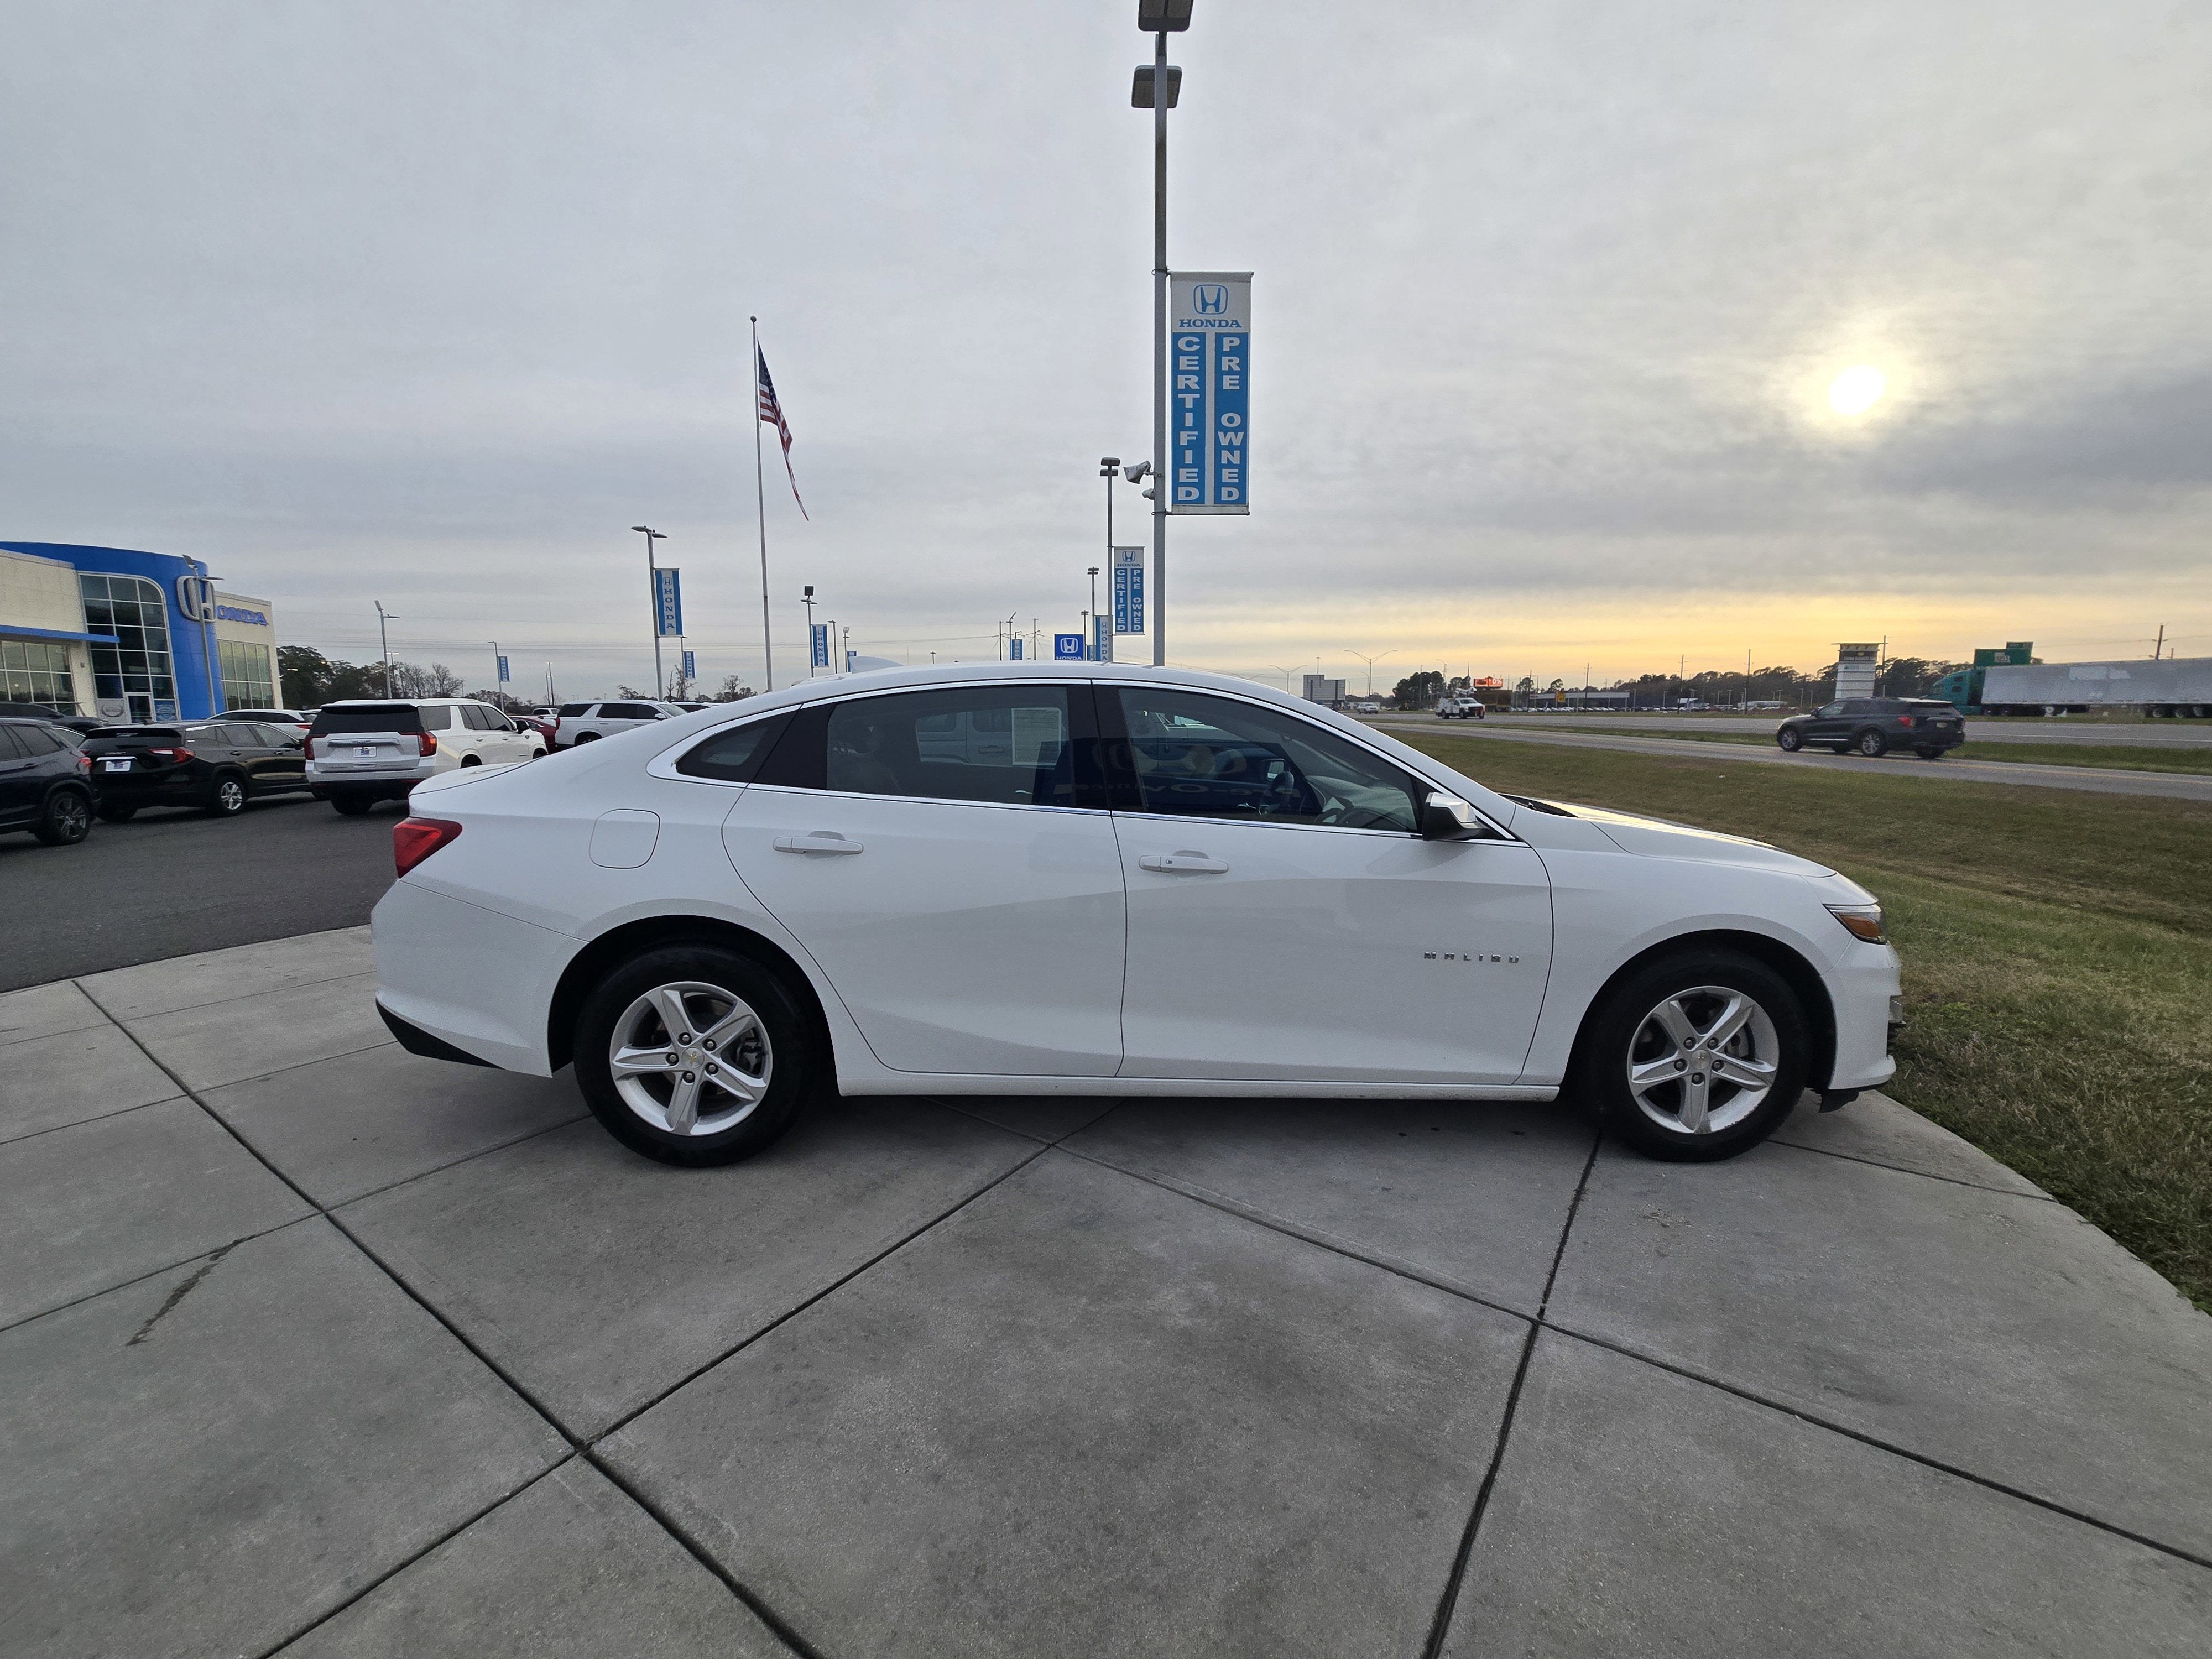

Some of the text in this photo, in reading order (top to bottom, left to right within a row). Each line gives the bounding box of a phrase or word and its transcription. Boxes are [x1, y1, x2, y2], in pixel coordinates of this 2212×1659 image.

[1178, 319, 1242, 328] HONDA
[1177, 336, 1201, 501] CERTIFIED
[1218, 337, 1244, 501] PRE OWNED
[216, 604, 269, 626] ONDA
[664, 588, 675, 629] HONDA
[1117, 570, 1126, 631] CERTIFIED
[1132, 597, 1142, 631] OWNED
[1424, 951, 1520, 963] MALIBU
